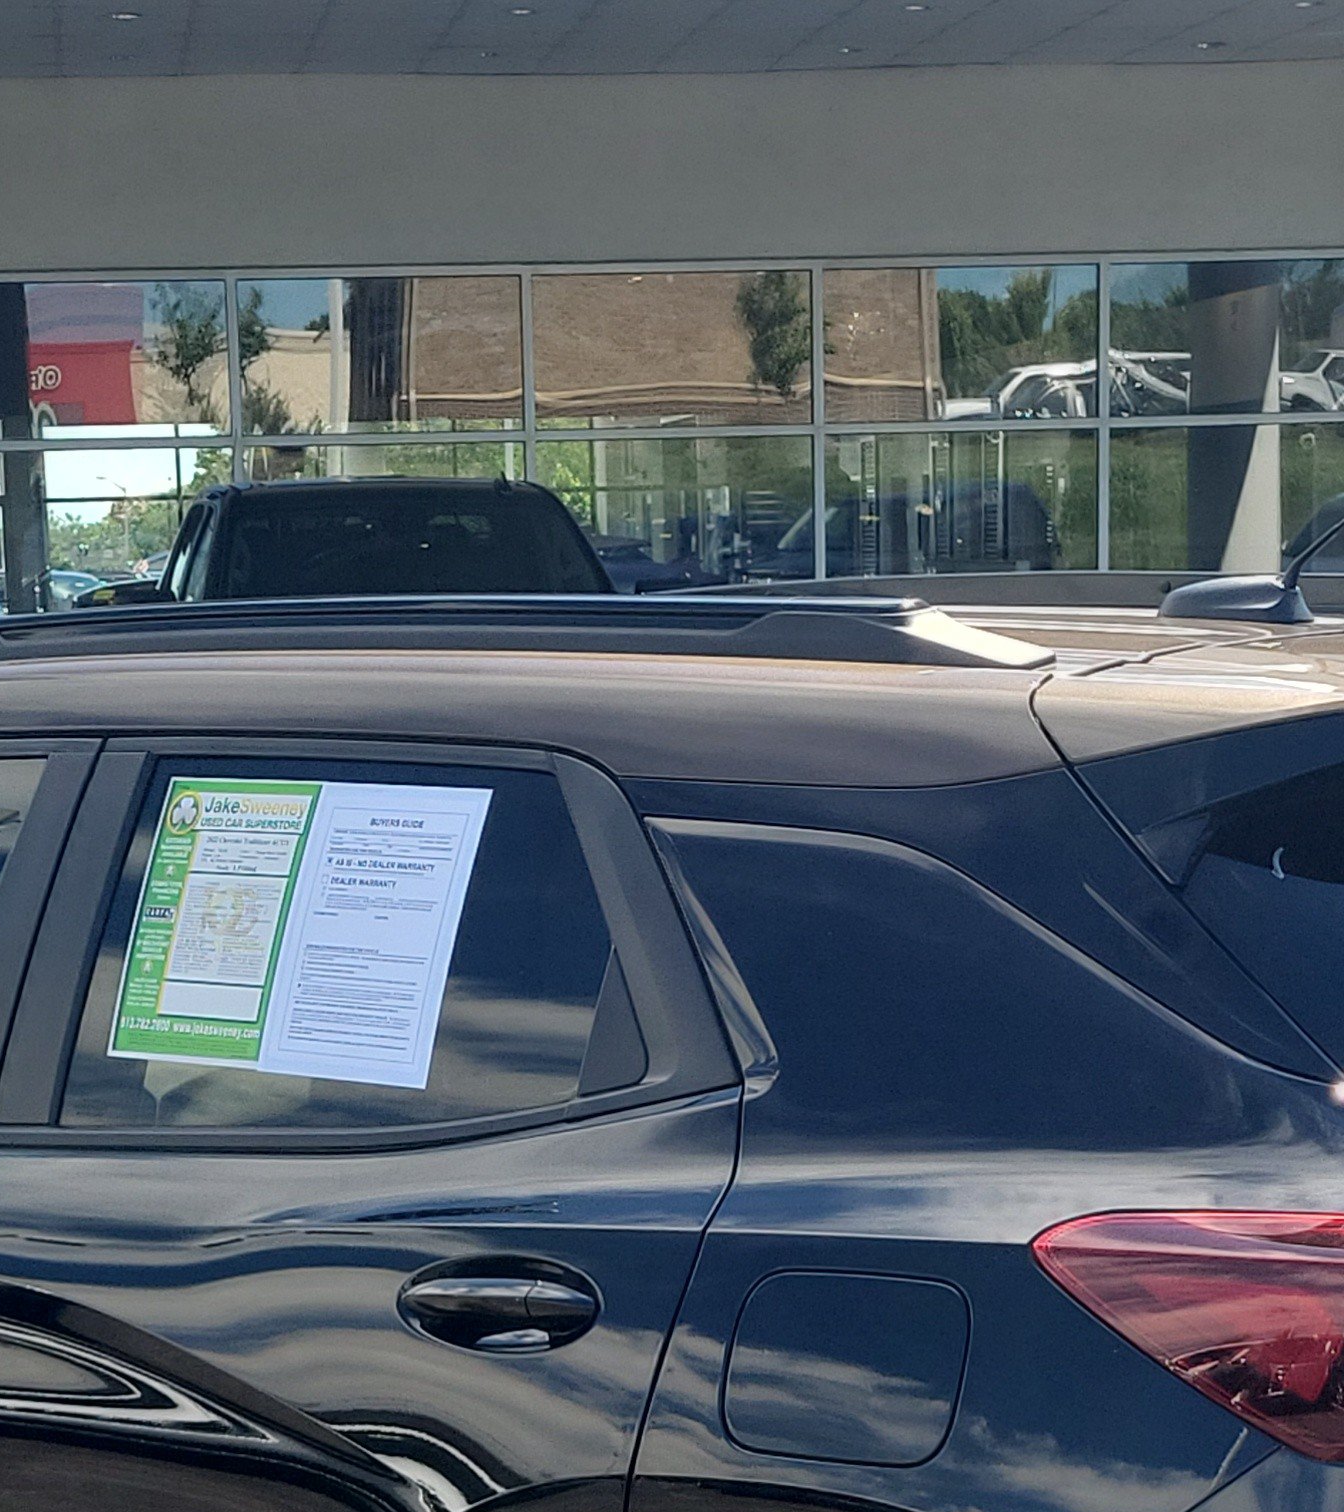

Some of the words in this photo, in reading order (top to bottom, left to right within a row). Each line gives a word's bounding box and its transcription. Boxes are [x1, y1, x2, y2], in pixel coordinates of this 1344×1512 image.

[200, 818, 224, 827] USED
[225, 819, 244, 828] CAR
[245, 819, 302, 830] SUPERSTORE
[369, 860, 395, 869] DEALER
[397, 862, 435, 872] WARRANTY
[331, 876, 358, 886] DEALER
[358, 878, 397, 888] WARRANTY
